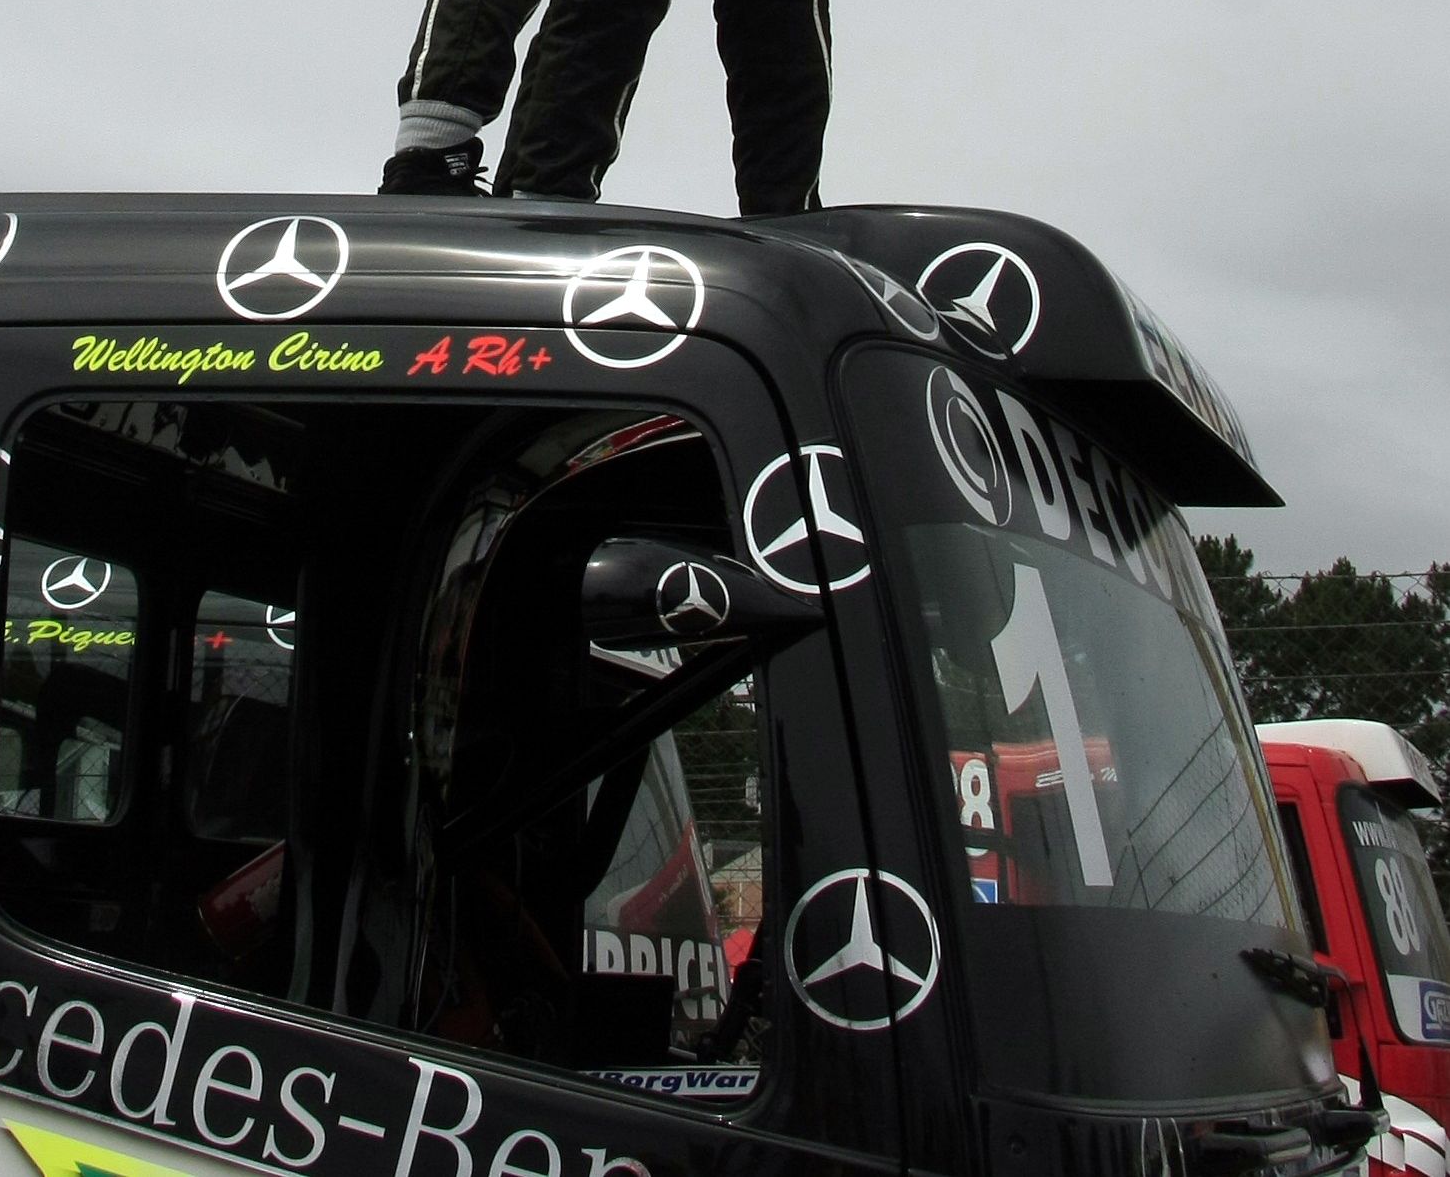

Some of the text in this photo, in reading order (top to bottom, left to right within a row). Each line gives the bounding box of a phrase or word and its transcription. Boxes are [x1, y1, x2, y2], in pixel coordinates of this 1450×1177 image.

[72, 335, 256, 385] Wellington
[267, 331, 384, 372] Cirino
[407, 335, 451, 376] A
[27, 620, 136, 652] Pique
[990, 562, 1114, 887] 1
[1375, 857, 1420, 955] 88
